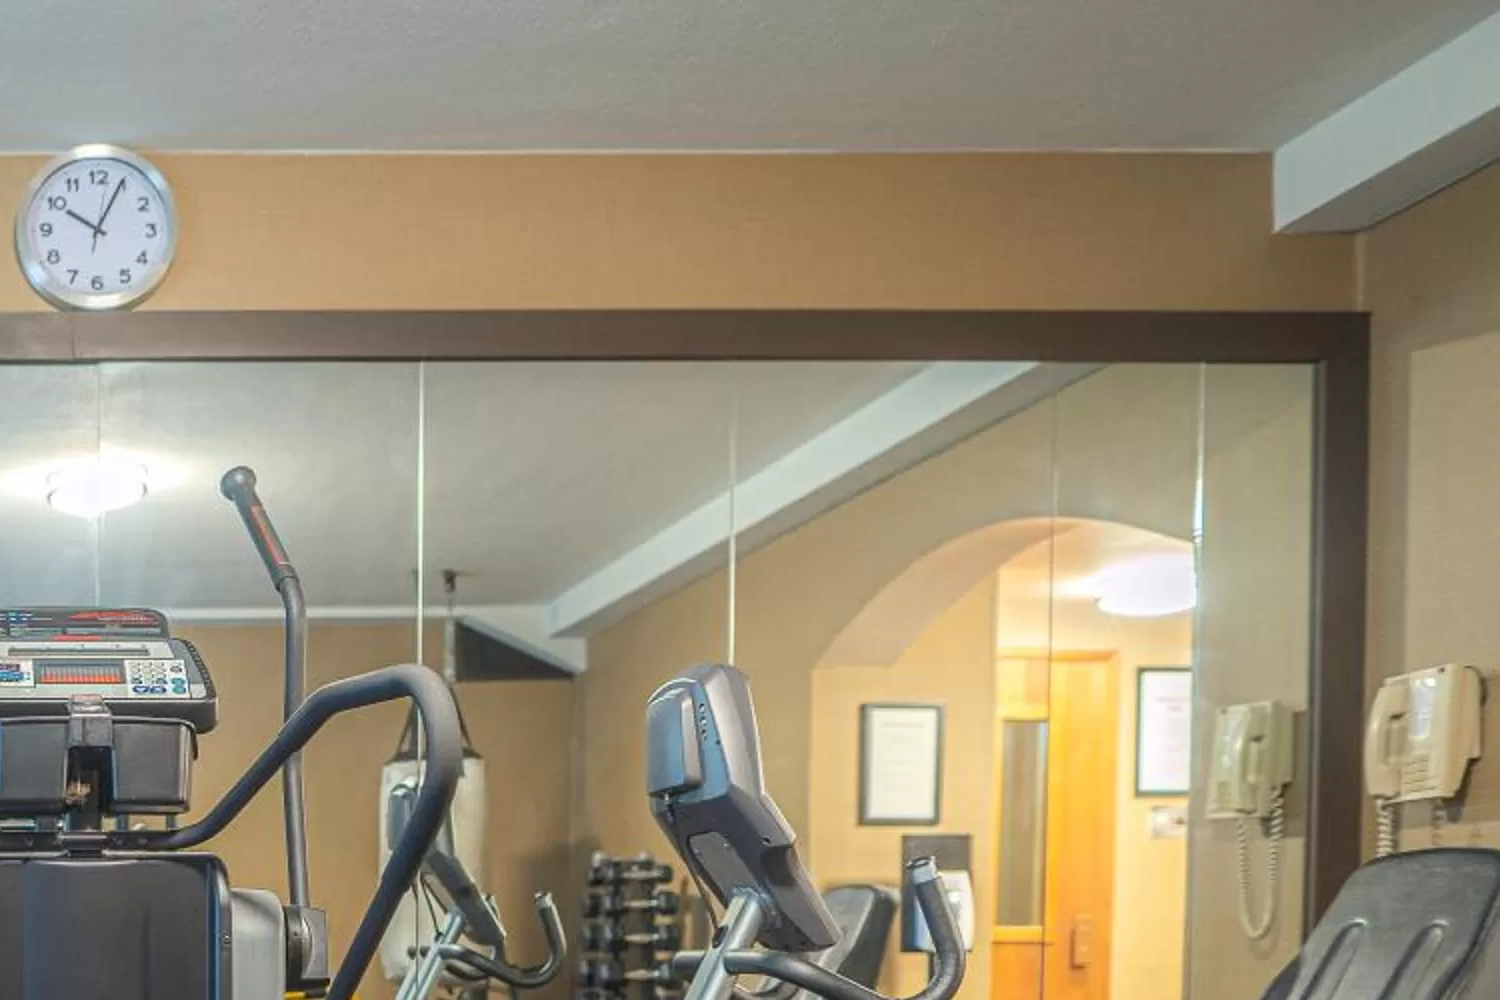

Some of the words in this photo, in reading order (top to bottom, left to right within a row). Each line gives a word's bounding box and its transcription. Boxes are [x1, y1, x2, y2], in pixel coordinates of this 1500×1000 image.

[88, 169, 109, 185] 12
[66, 178, 79, 192] 11
[47, 195, 67, 211] 10
[136, 197, 149, 212] 2
[39, 222, 53, 237] 9
[145, 223, 157, 238] 3
[47, 250, 60, 265] 8
[135, 250, 148, 265] 4
[67, 269, 79, 285] 7
[90, 275, 104, 291] 6
[119, 269, 131, 284] 5
